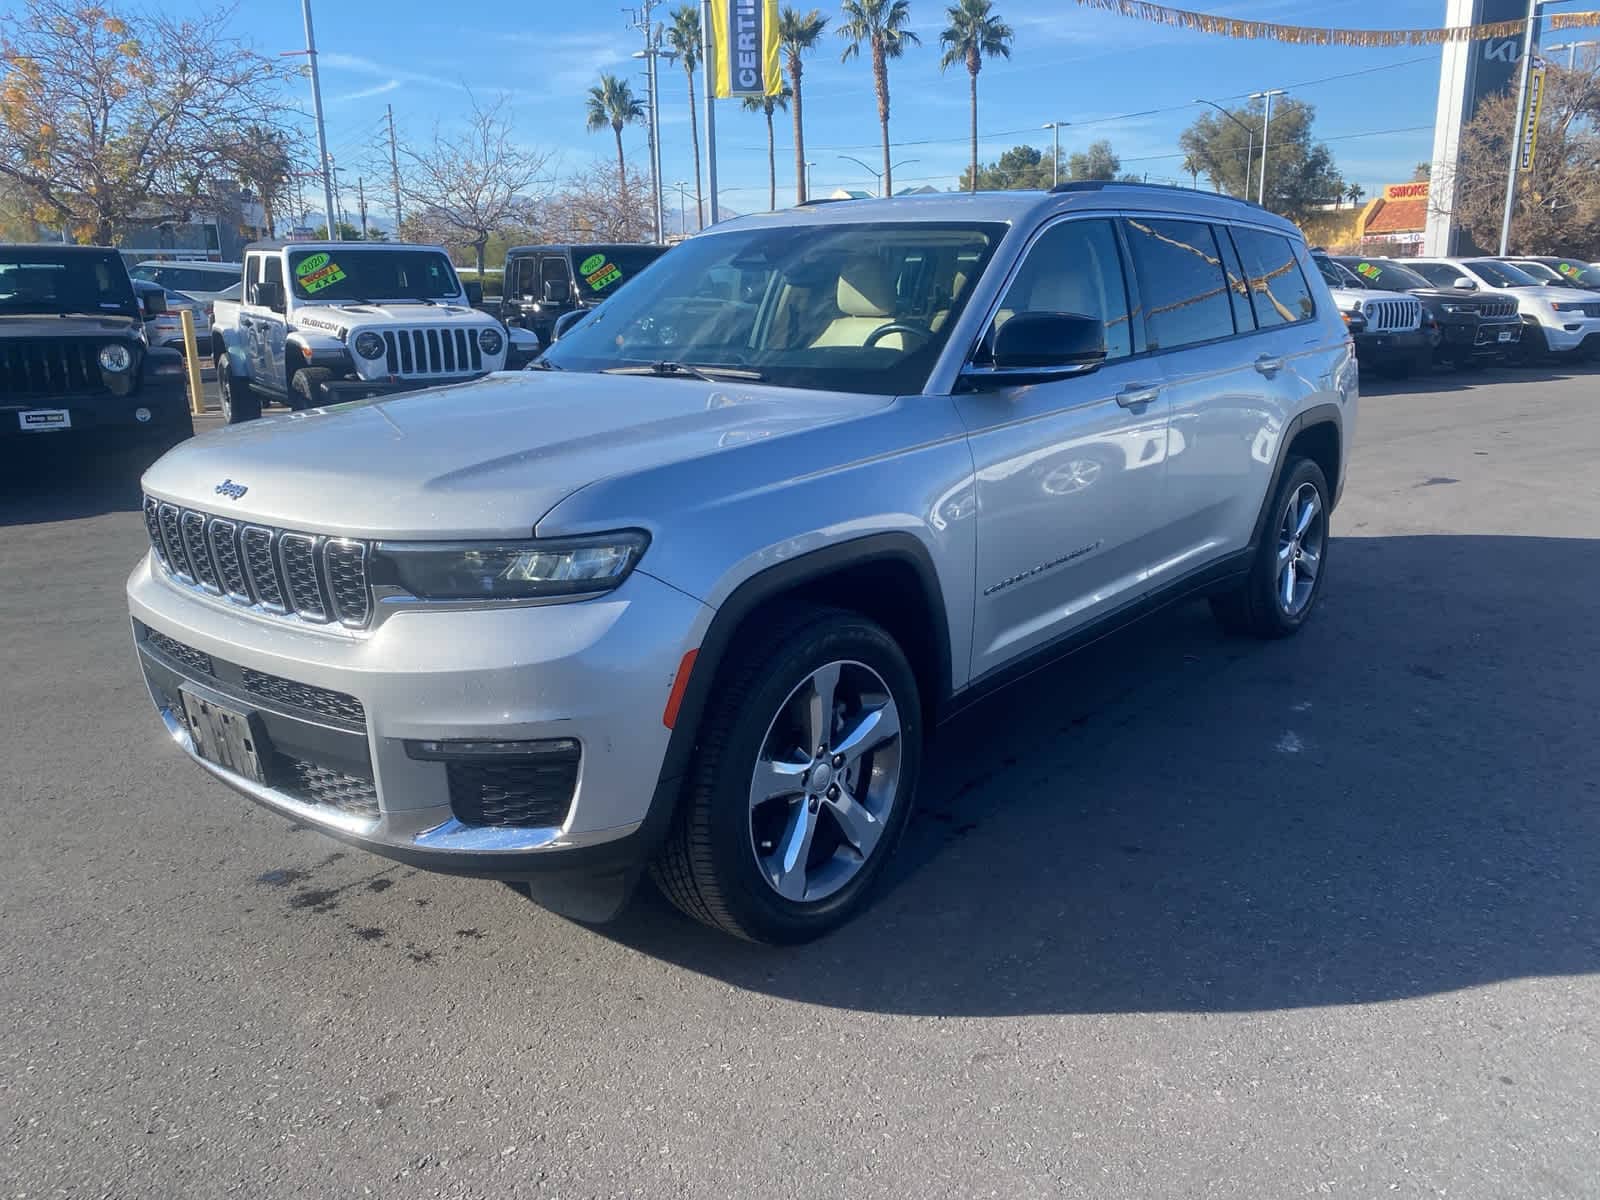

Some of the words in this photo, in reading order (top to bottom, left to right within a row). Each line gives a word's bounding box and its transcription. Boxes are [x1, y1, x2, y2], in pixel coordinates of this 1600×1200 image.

[1484, 39, 1522, 62] KI
[1389, 184, 1429, 198] SMOKE
[302, 255, 325, 274] 2020
[302, 317, 339, 332] RUBICON
[215, 479, 248, 501] Jeep
